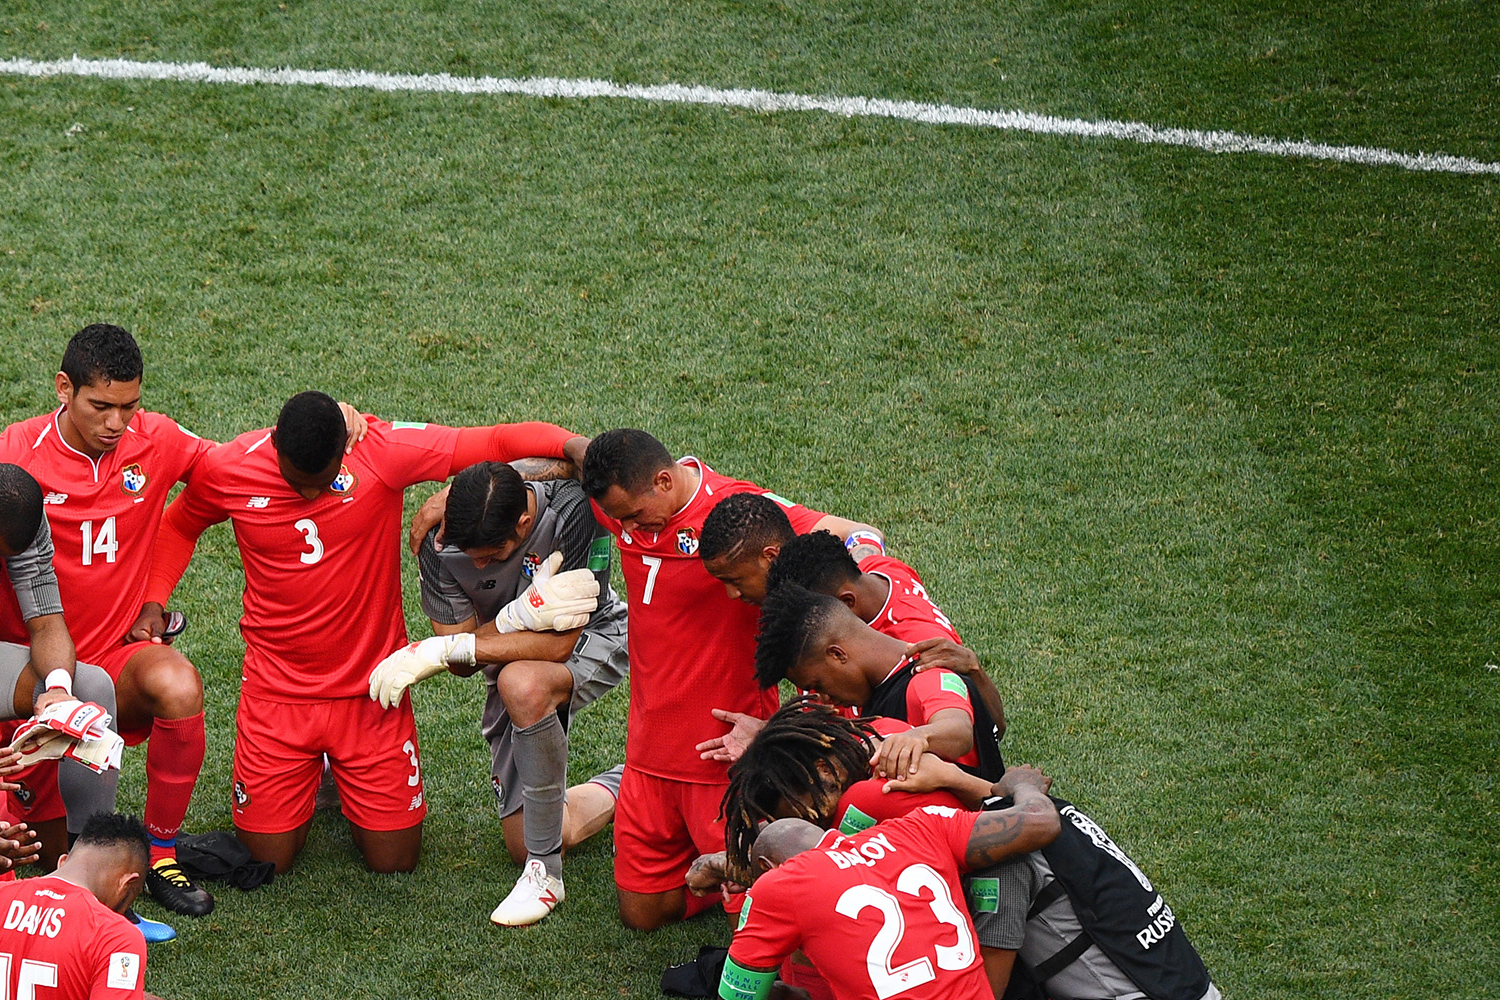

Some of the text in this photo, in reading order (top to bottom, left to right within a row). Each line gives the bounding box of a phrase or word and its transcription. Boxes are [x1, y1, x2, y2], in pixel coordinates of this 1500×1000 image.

[80, 516, 118, 566] 14
[294, 518, 324, 564] 3
[642, 555, 662, 605] 7
[403, 740, 419, 786] 3
[825, 833, 897, 870] BALOY
[3, 900, 65, 938] DAVIS
[835, 863, 976, 1000] 23
[735, 992, 754, 1000] FIFA
